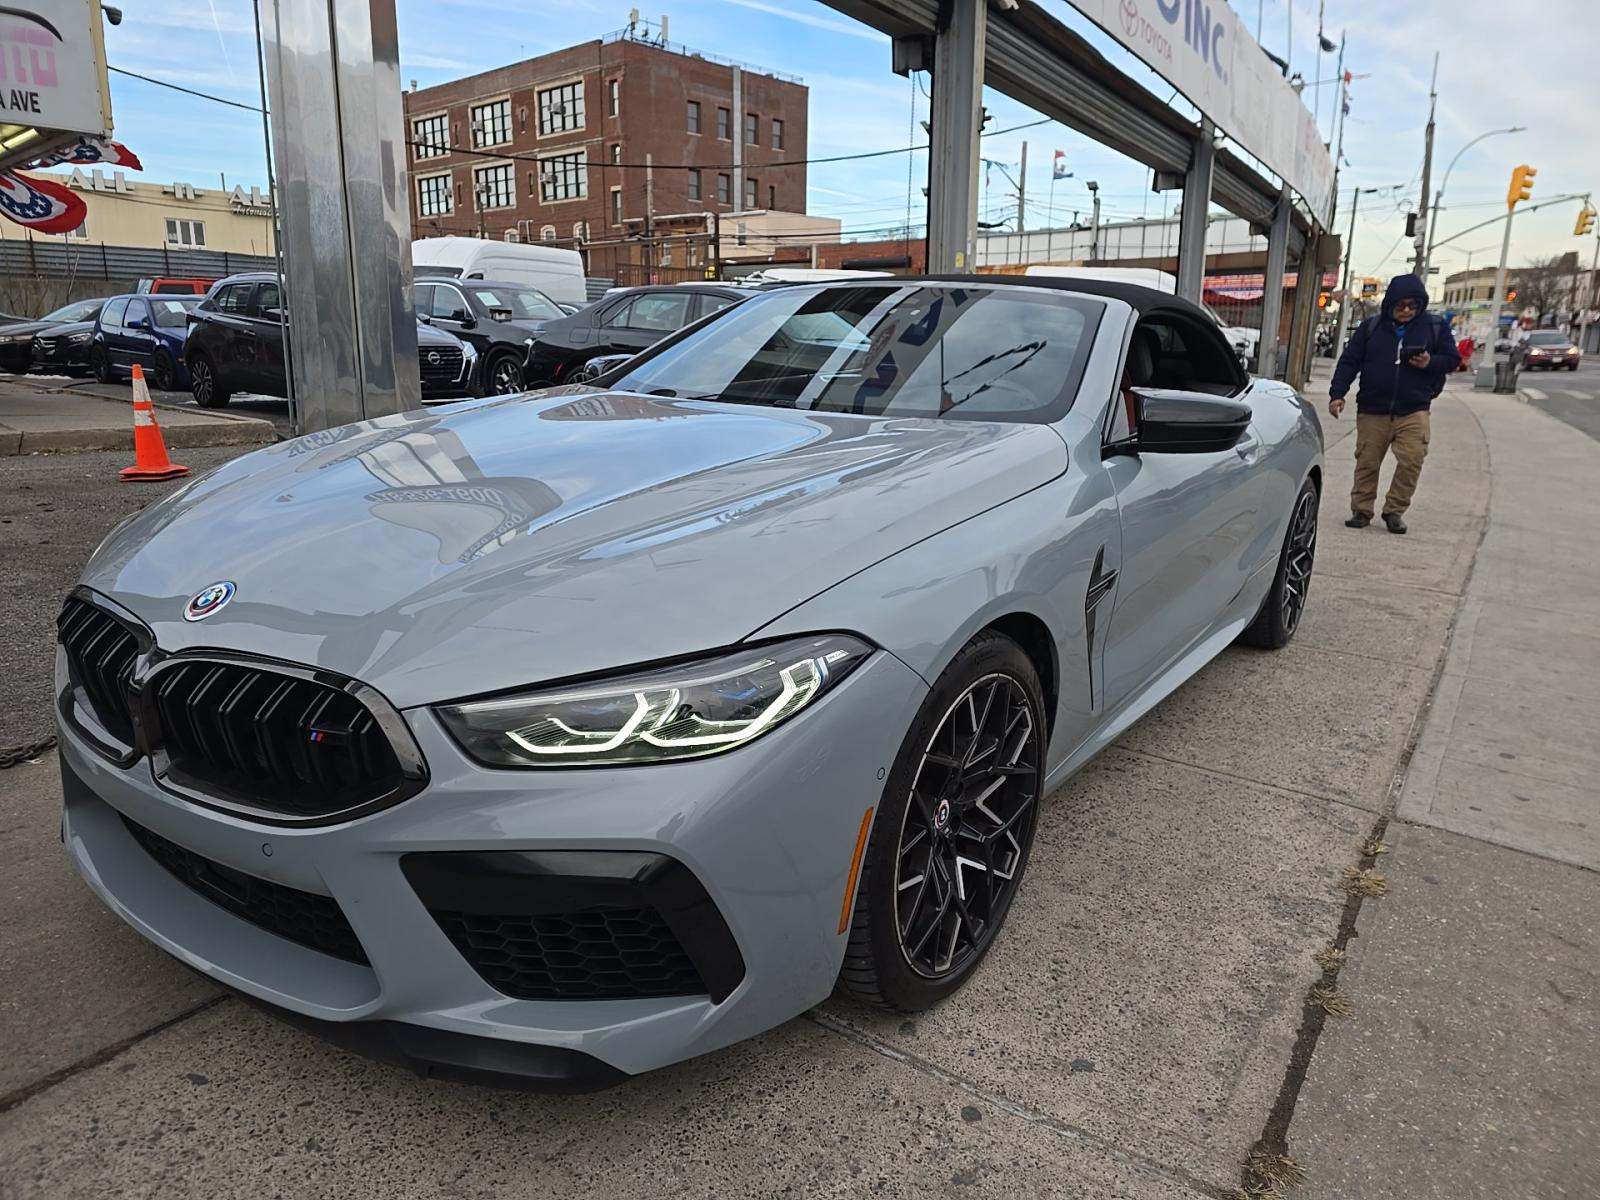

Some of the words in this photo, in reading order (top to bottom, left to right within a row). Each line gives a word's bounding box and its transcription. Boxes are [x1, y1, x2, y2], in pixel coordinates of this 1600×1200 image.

[1139, 17, 1172, 63] TOYOTA
[1184, 0, 1228, 85] INC.
[10, 88, 42, 113] AVE
[66, 167, 135, 194] ALL
